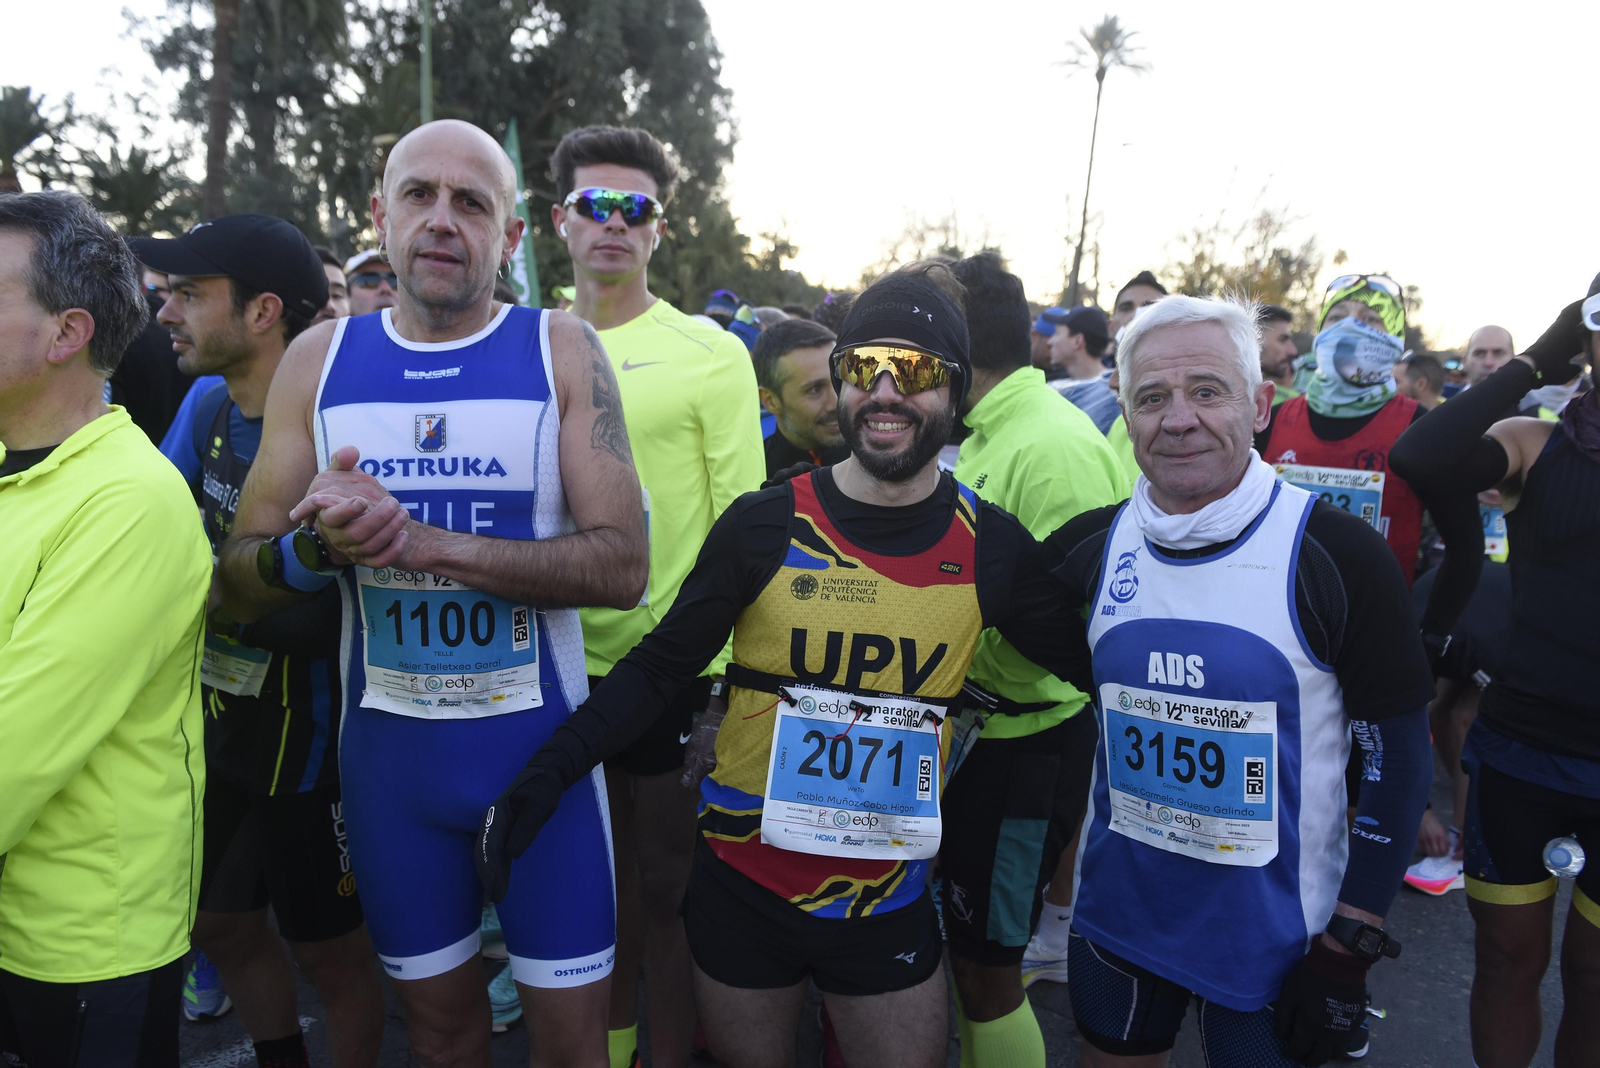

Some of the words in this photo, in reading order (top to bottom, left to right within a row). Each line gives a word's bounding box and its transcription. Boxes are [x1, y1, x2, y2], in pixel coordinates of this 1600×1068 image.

[360, 456, 508, 478] OSTRUKA
[940, 563, 961, 573] 42K
[821, 585, 878, 596] POLITÈCNICA
[823, 577, 879, 588] UNIVERSITAT
[835, 594, 876, 604] VALÈNCIA
[386, 599, 495, 648] 1100
[397, 660, 422, 671] Asier
[424, 662, 472, 672] Telletxea
[475, 658, 501, 671] Garai
[790, 627, 949, 695] UPV
[1147, 651, 1205, 689] ADS
[445, 675, 475, 692] edp
[412, 697, 433, 707] HOKA
[818, 699, 849, 718] edp
[872, 704, 920, 719] maratón
[1134, 697, 1161, 716] edp
[1179, 703, 1239, 720] maratón
[883, 714, 918, 728] sevilla
[1194, 715, 1240, 729] sevilla
[779, 752, 787, 770] CAJÓN
[797, 730, 904, 787] 2071
[1124, 725, 1225, 789] 3159
[847, 785, 865, 793] WeTo
[1162, 782, 1187, 793] Carmelo
[796, 791, 824, 803] Pablo
[826, 795, 888, 810] Muñoz-Cobo
[890, 803, 915, 813] Higon
[1119, 780, 1138, 794] Jesús
[1140, 788, 1175, 804] Carmelo
[1177, 798, 1210, 812] Grueso
[1213, 805, 1255, 817] Galindo
[852, 812, 879, 830] edp
[1174, 812, 1201, 830] edp
[814, 833, 837, 843] HOKA
[1145, 825, 1164, 837] HOKA
[554, 962, 603, 977] OSTRUKA
